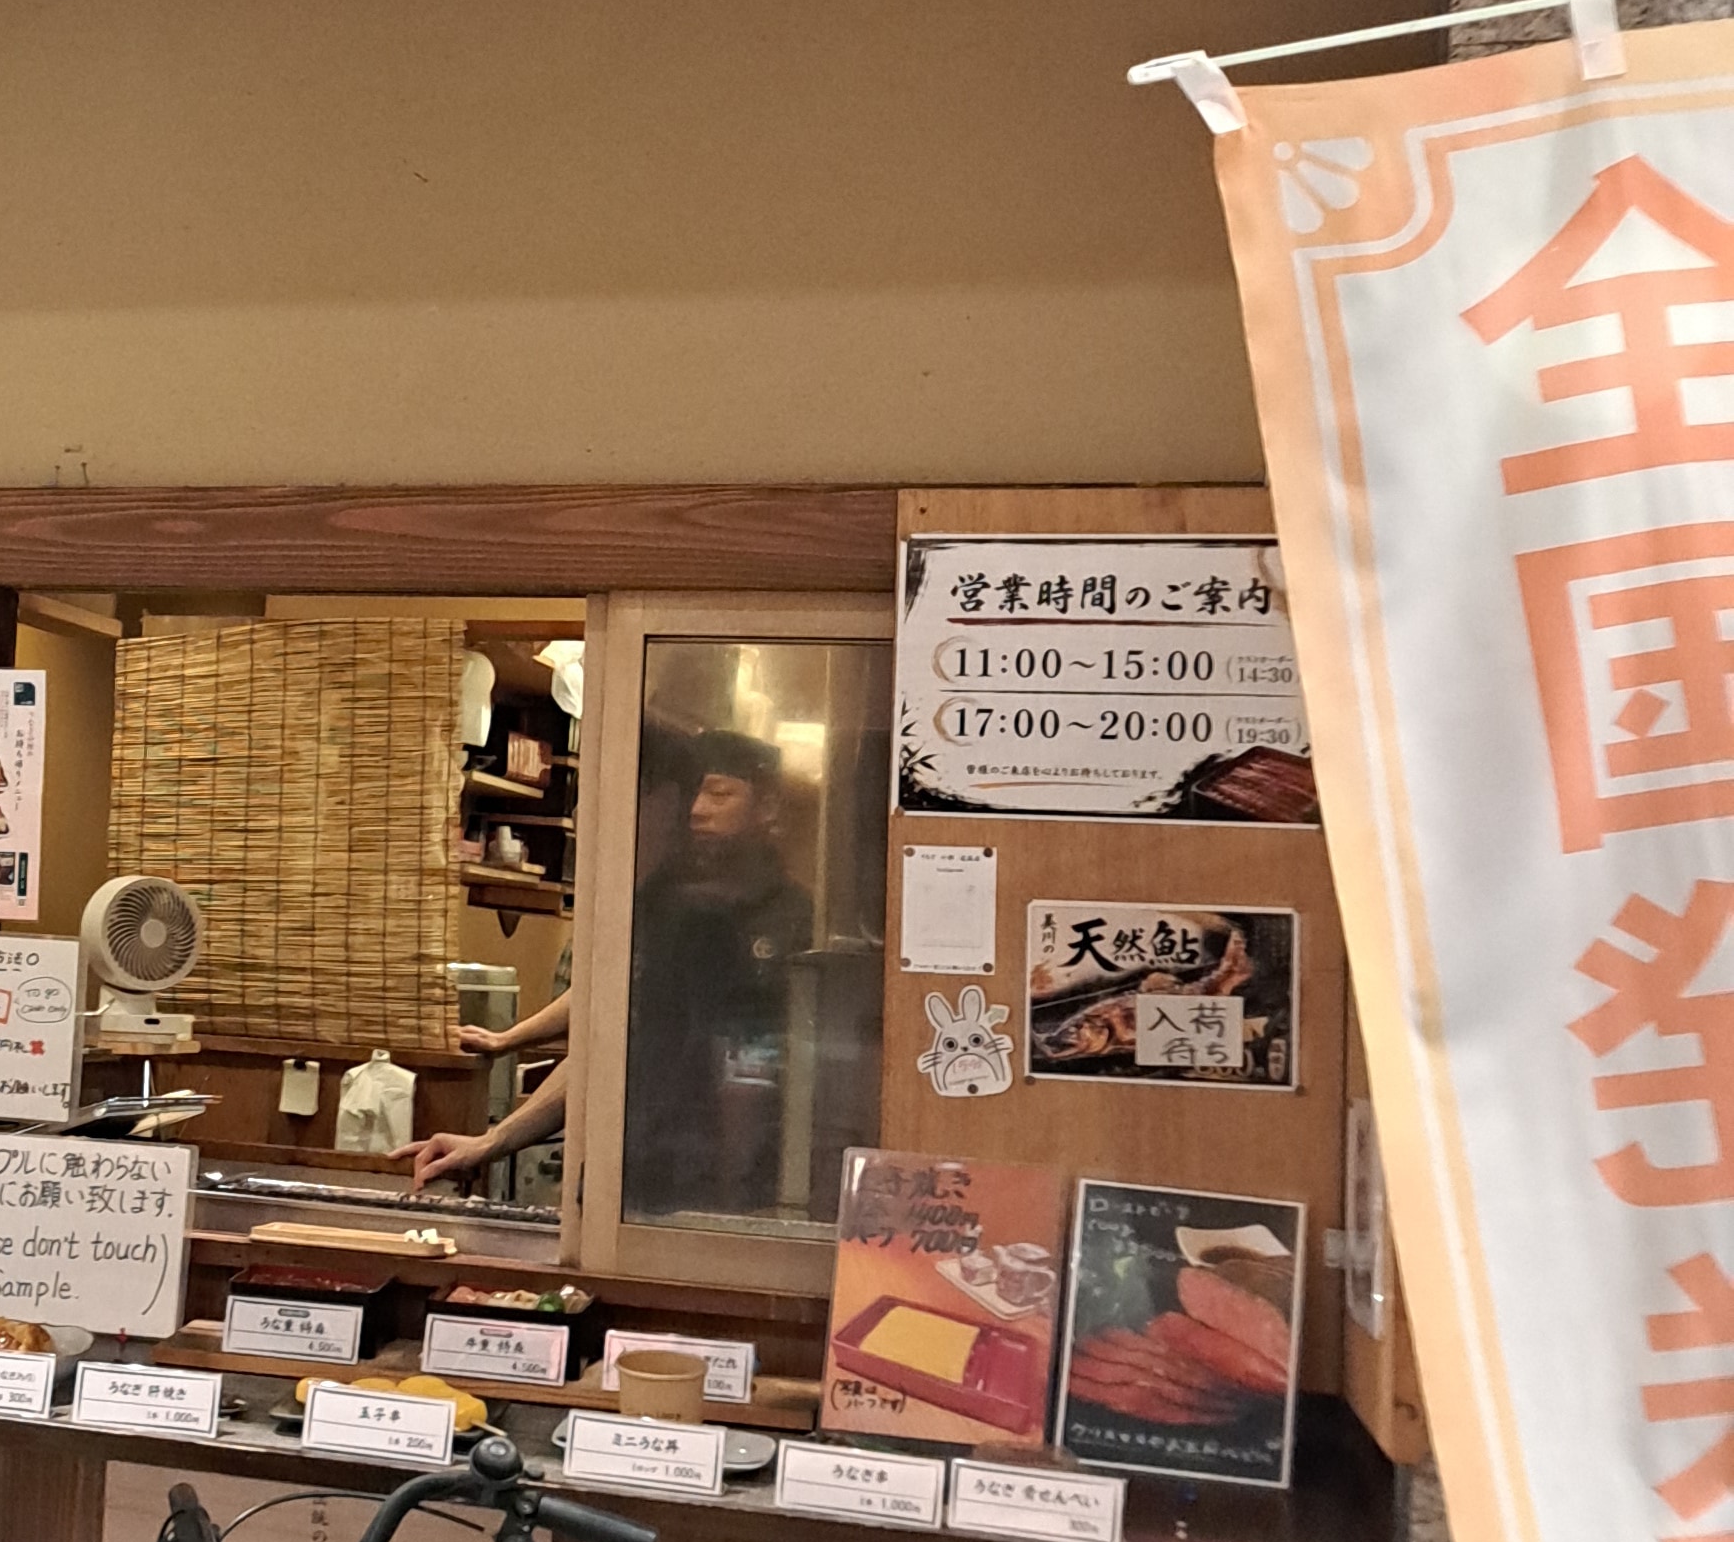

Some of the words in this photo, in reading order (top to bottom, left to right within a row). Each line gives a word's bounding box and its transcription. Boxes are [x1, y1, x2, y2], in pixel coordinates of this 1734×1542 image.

[950, 572, 1272, 615] 営業時間のご案内
[1057, 917, 1201, 973] 天然鮎
[1147, 1001, 1227, 1038] 入荷
[1161, 1037, 1229, 1066] 待ち
[23, 1225, 80, 1260] don't
